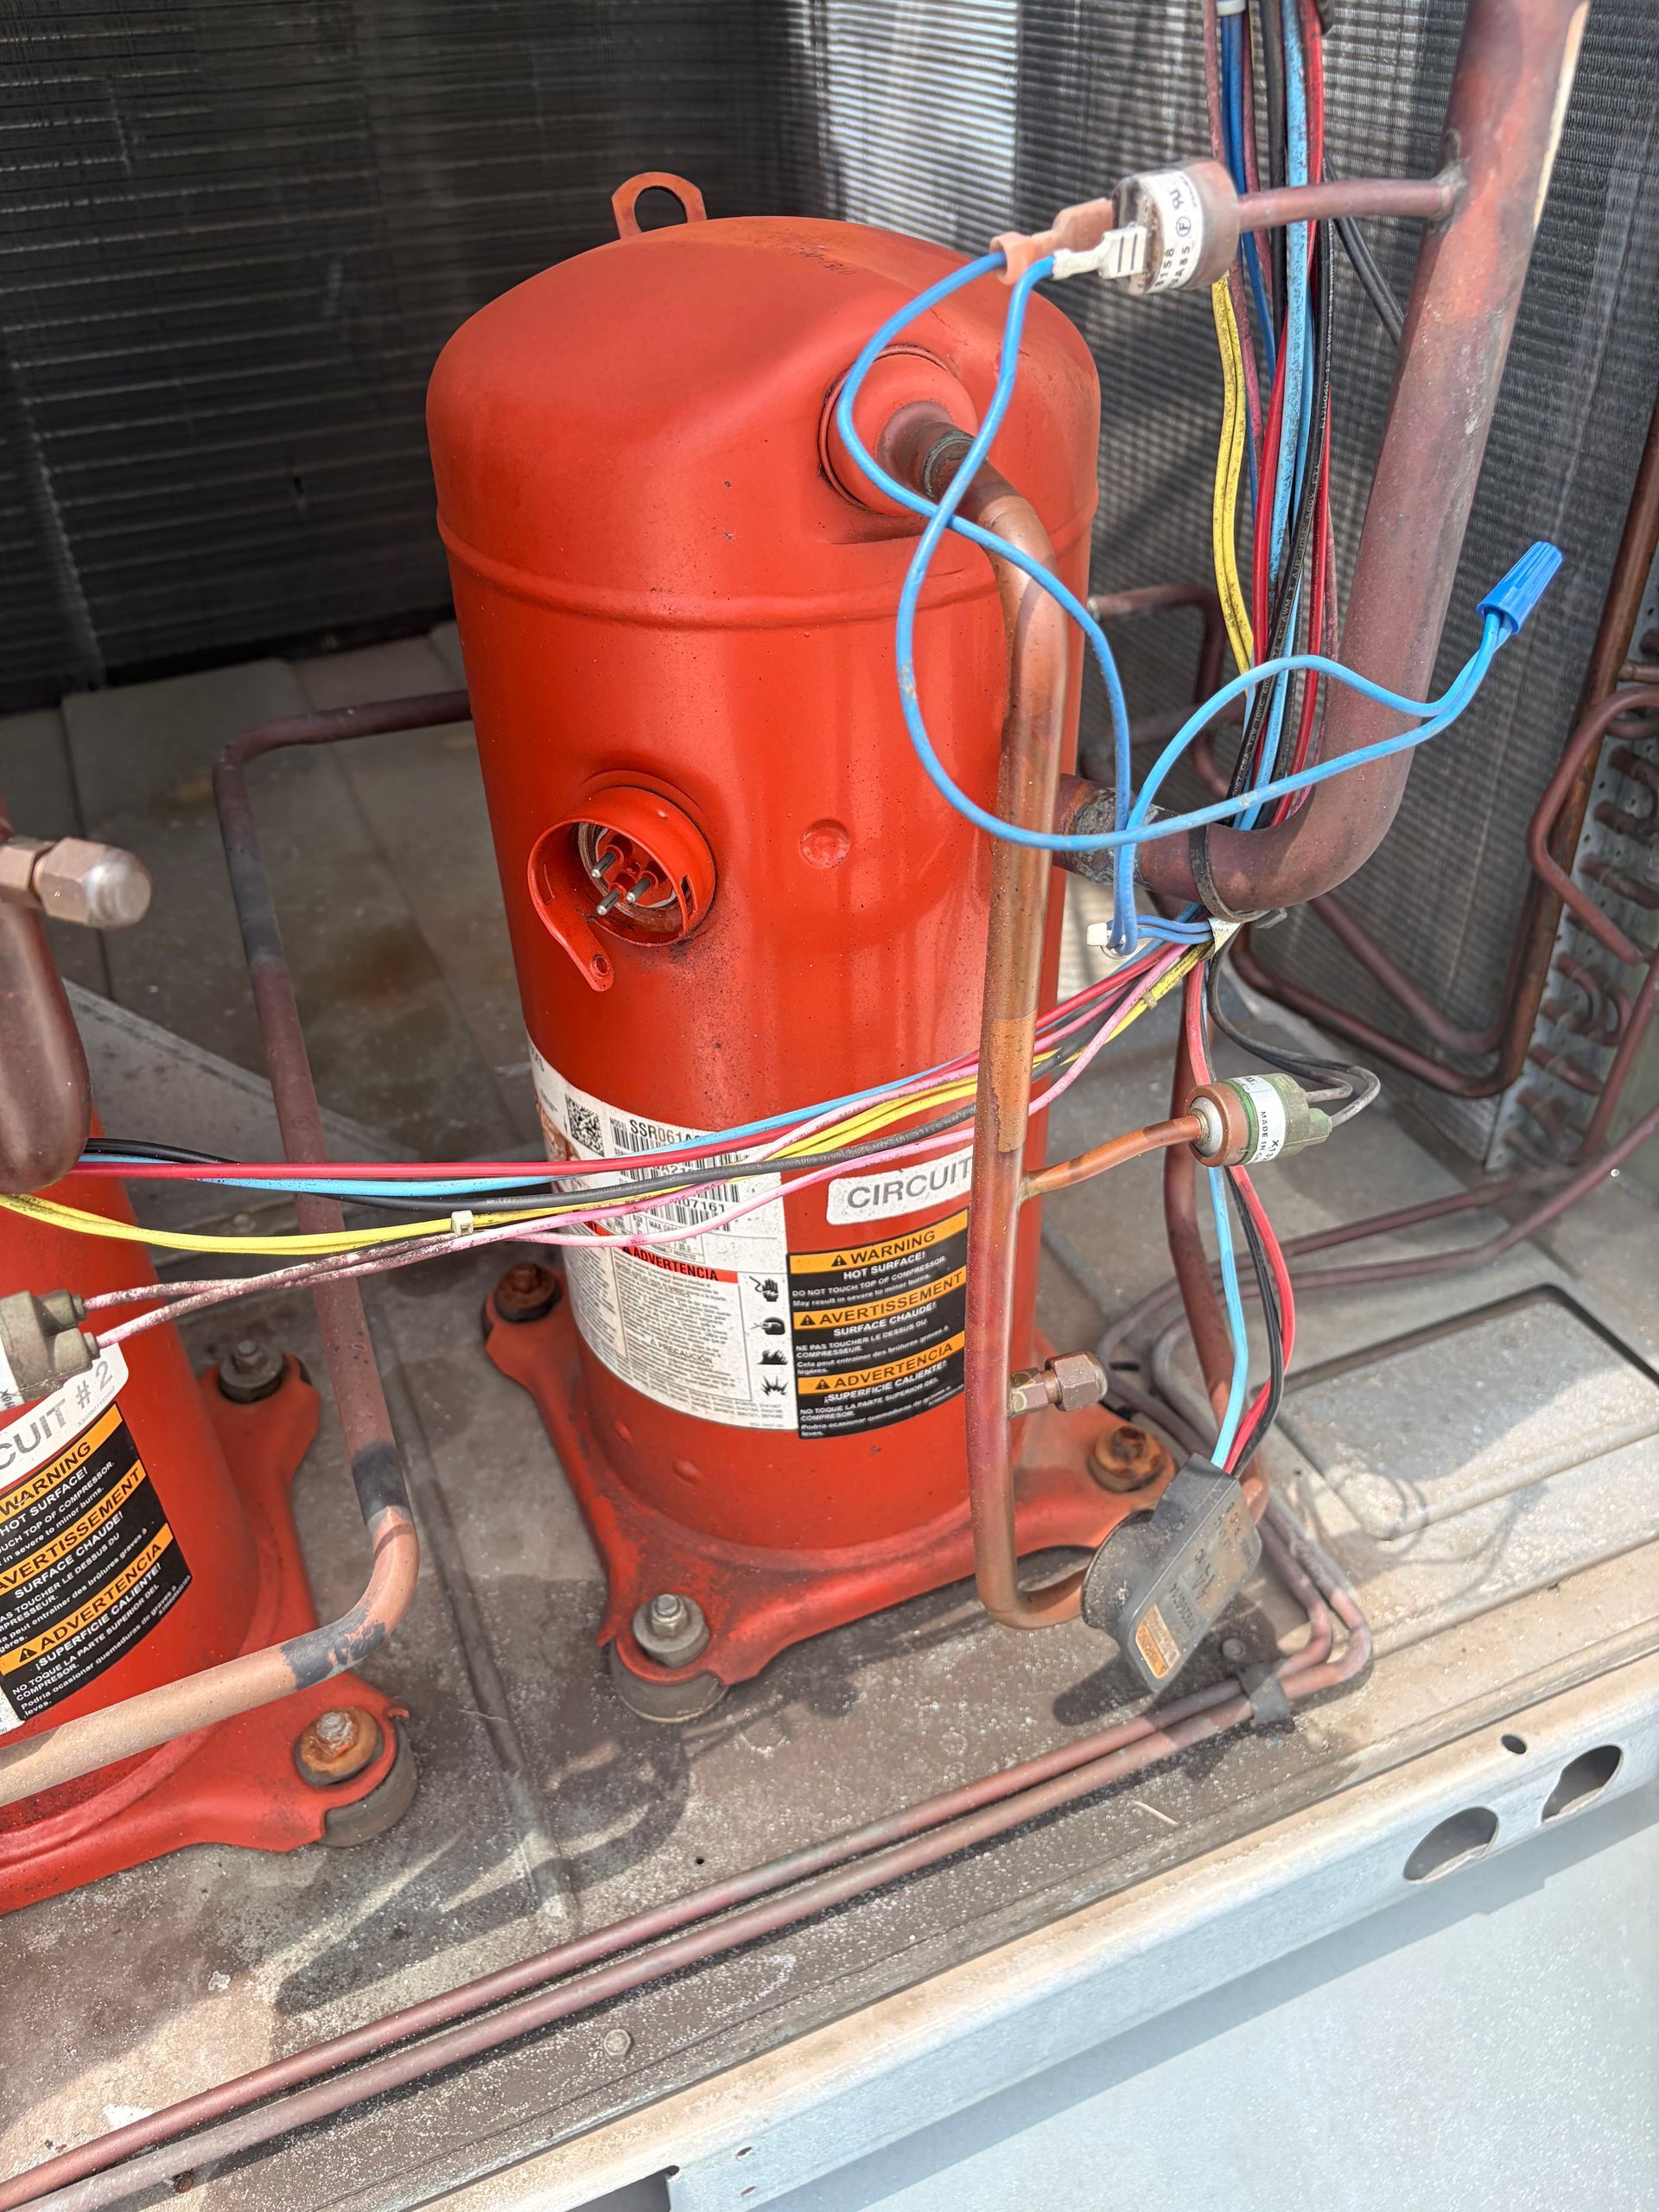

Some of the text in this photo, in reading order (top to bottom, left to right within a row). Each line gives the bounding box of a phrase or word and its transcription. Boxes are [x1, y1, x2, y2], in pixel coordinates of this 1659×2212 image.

[1239, 753, 1252, 771] CSA
[1281, 599, 1293, 622] AWM
[1304, 492, 1315, 519] 600V
[1259, 1141, 1267, 1151] IN
[1260, 1110, 1268, 1138] MADE
[846, 1156, 973, 1209] CIRCUIT
[632, 1246, 720, 1282] ADVERTENCIA
[843, 1250, 926, 1281] HOT SURFACE!
[850, 1230, 936, 1265] WARNING
[791, 1255, 947, 1298] DO NOT TOUCH TOP OF COMPRESSOR.
[792, 1299, 810, 1307] May
[811, 1297, 836, 1306] result
[847, 1291, 874, 1301] severe
[874, 1287, 883, 1296] to
[884, 1281, 907, 1293] minor
[908, 1274, 931, 1287] burns.
[818, 1272, 963, 1325] AVERTISSEMENT
[809, 1343, 827, 1351] PAS
[829, 1336, 869, 1350] TOUCHER
[870, 1333, 881, 1342] LE
[882, 1323, 914, 1339] DESSUS
[915, 1318, 927, 1328] DU
[833, 1301, 938, 1337] SURFACE CHAUDE!
[796, 1345, 862, 1359] COMPRESSEUR.
[834, 1342, 954, 1389] ADVERTENCIA
[894, 1359, 948, 1388] CALIENTE!
[75, 1379, 92, 1410] #
[95, 1360, 113, 1392] 2
[814, 1404, 844, 1414] TOQUE
[856, 1396, 884, 1408] PARTE
[885, 1384, 924, 1402] SUPERIOR
[0, 1441, 92, 1516] WARNING
[1, 1465, 89, 1537] HOT SURFACE!
[23, 1522, 44, 1537] TOP
[44, 1510, 58, 1527] OF
[58, 1460, 116, 1513] COMPRESSOR.
[0, 1465, 141, 1592] AVERTISSEMENT
[3, 1486, 105, 1563] in severe to minor burns.
[14, 1510, 125, 1600] SURFACE CHAUDE!
[15, 1583, 63, 1614] TOUCHER
[62, 1573, 75, 1586] LE
[75, 1544, 109, 1575] DESSUS
[109, 1532, 122, 1546] DU
[10, 1624, 32, 1641] peut
[72, 1584, 87, 1599] des
[119, 1534, 143, 1559] graves
[41, 1542, 162, 1651] ADVERTENCIA
[12, 1684, 28, 1695] NO
[28, 1663, 63, 1686] TOQUE
[64, 1651, 78, 1666] LA
[77, 1632, 107, 1657] PARTE
[106, 1598, 146, 1636] SUPERIOR
[144, 1583, 161, 1599] DEL
[35, 1612, 111, 1672] ¡SUPERFICIE
[111, 1561, 163, 1616] CALIENTE!
[52, 1662, 95, 1694] ocasionar
[95, 1623, 142, 1665] quemaduras
[141, 1613, 151, 1627] de
[150, 1592, 173, 1618] graves
[16, 1663, 80, 1702] COMPRESOR.
